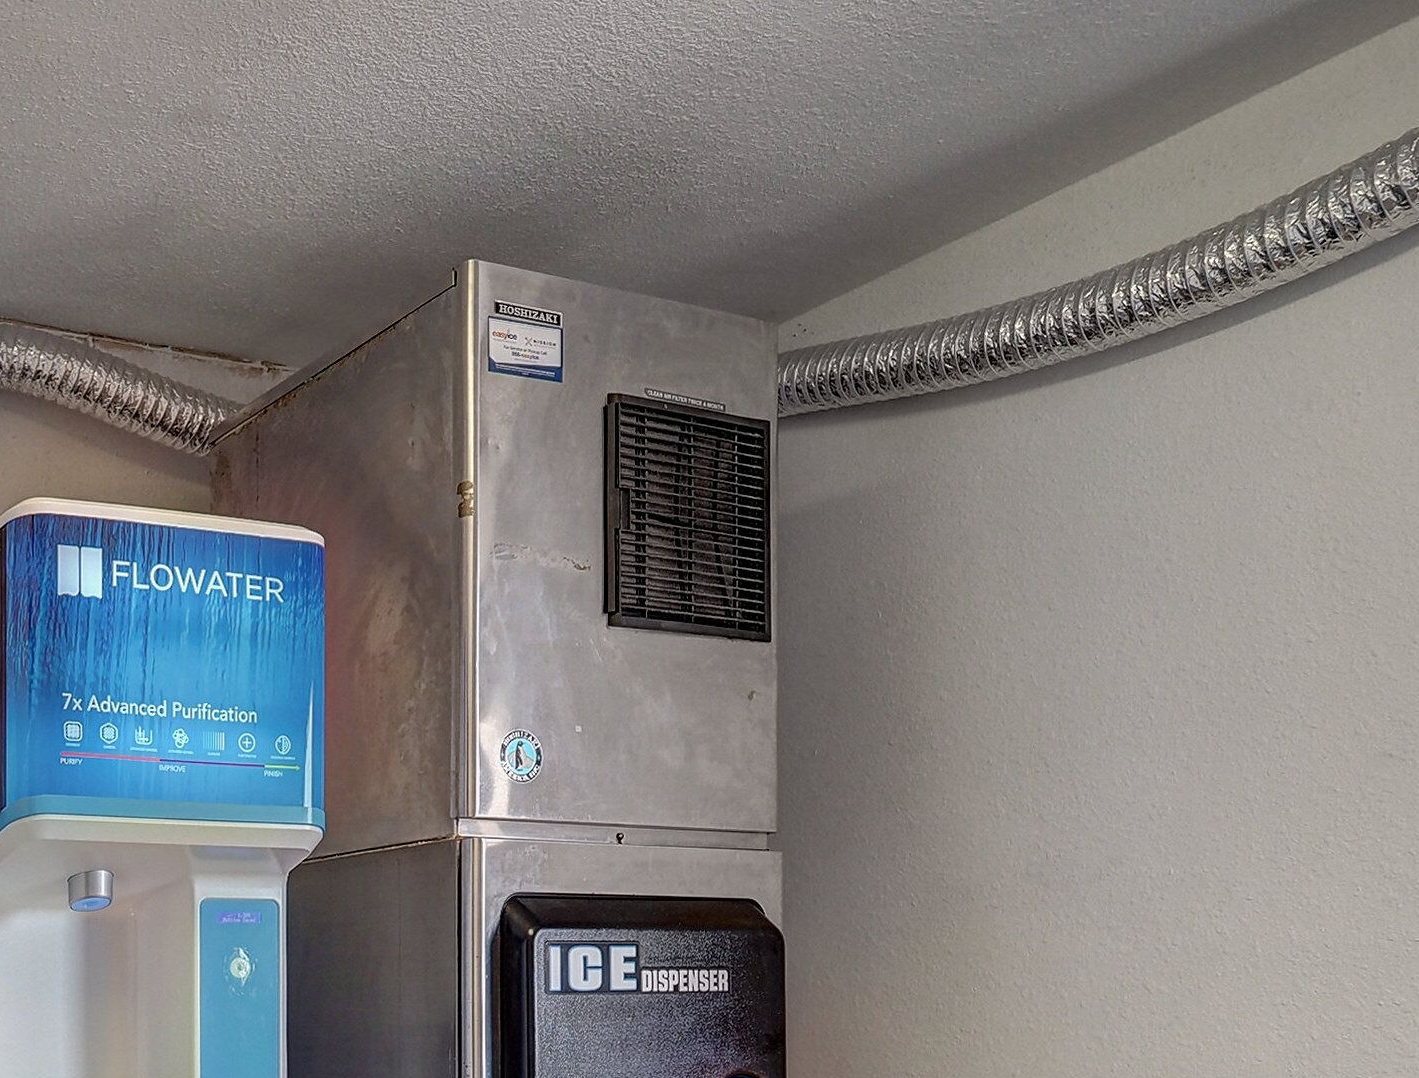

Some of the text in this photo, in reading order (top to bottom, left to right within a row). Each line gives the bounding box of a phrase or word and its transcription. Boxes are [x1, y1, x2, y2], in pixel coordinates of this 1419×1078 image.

[499, 304, 558, 324] HOSHIZAKI
[111, 560, 284, 603] FLOWATER
[62, 693, 257, 723] 7x Advanced Purification
[548, 943, 729, 993] ICE DISPENSER
